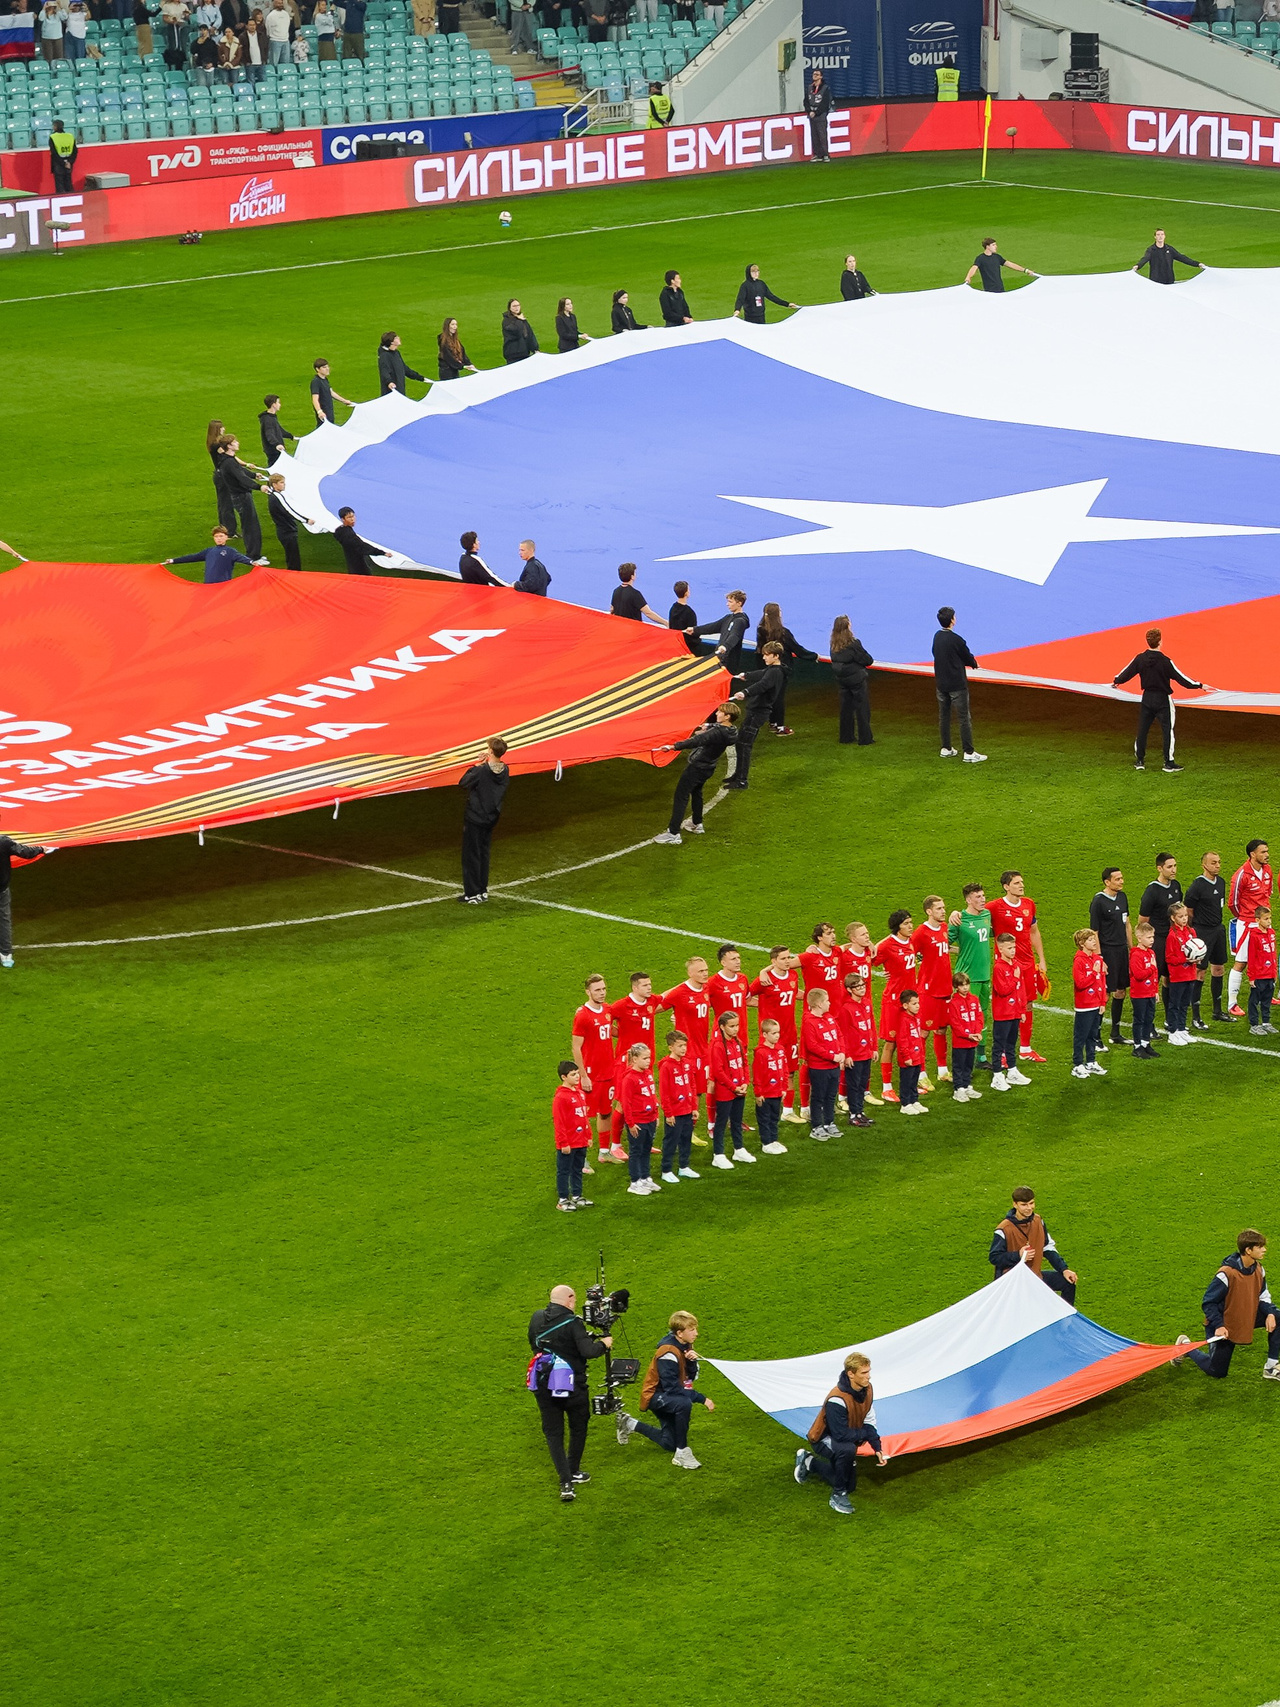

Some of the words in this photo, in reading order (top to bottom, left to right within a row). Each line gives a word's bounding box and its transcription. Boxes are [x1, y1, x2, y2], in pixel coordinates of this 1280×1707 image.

[908, 42, 958, 51] СТАДИОН
[209, 148, 225, 157] ОАО
[257, 140, 313, 153] ОФИЦИАЛЬНЫЙ
[210, 154, 266, 166] ТРАНСПОРТНЫЙ
[414, 134, 645, 203] СИЛЬНЫЕ
[229, 193, 286, 224] РОССИИ
[0, 627, 507, 776] ЗАЩИТНИКА
[0, 721, 389, 809] ЕЧЕСТВА
[1015, 917, 1023, 932] 3
[977, 928, 989, 943] 12
[938, 943, 949, 957] 74
[905, 954, 916, 970] 22
[824, 966, 838, 981] 25
[857, 965, 869, 978] 18
[730, 993, 742, 1008] 17
[779, 991, 794, 1006] 27
[695, 1003, 707, 1018] 10
[641, 1016, 650, 1031] 4
[599, 1024, 610, 1040] 67
